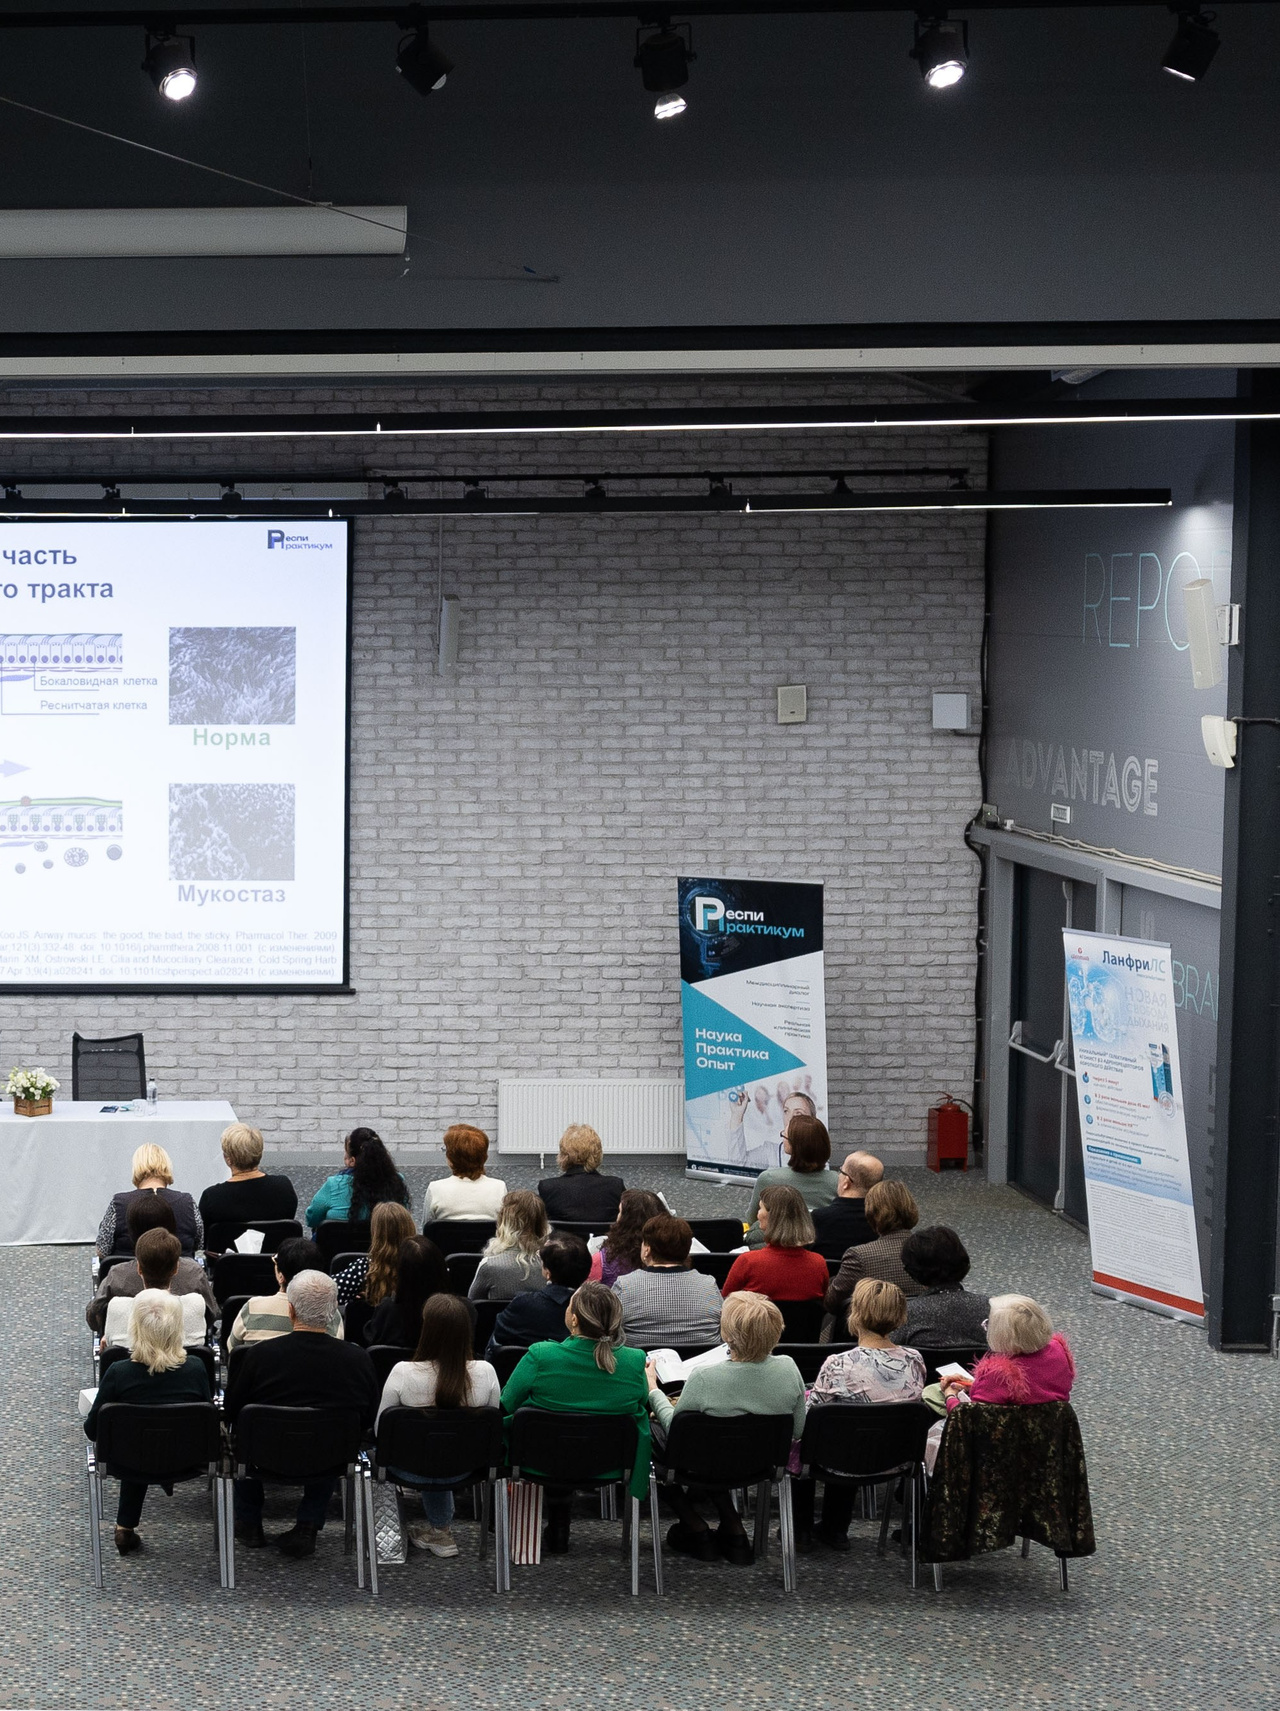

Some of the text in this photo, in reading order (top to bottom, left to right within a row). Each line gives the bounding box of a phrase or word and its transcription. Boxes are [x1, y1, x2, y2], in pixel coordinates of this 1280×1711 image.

[2, 549, 78, 566] часть
[27, 582, 114, 604] тракта
[40, 675, 158, 687] Бокаловидная клетка
[40, 700, 148, 711] Реснитчатая клетка
[193, 727, 271, 750] Норма
[1007, 737, 1159, 816] ADVANTAGE
[177, 884, 287, 906] Мукостаз
[695, 1027, 743, 1044] Наука
[695, 1042, 770, 1061] Практика
[695, 1057, 736, 1072] Опыт
